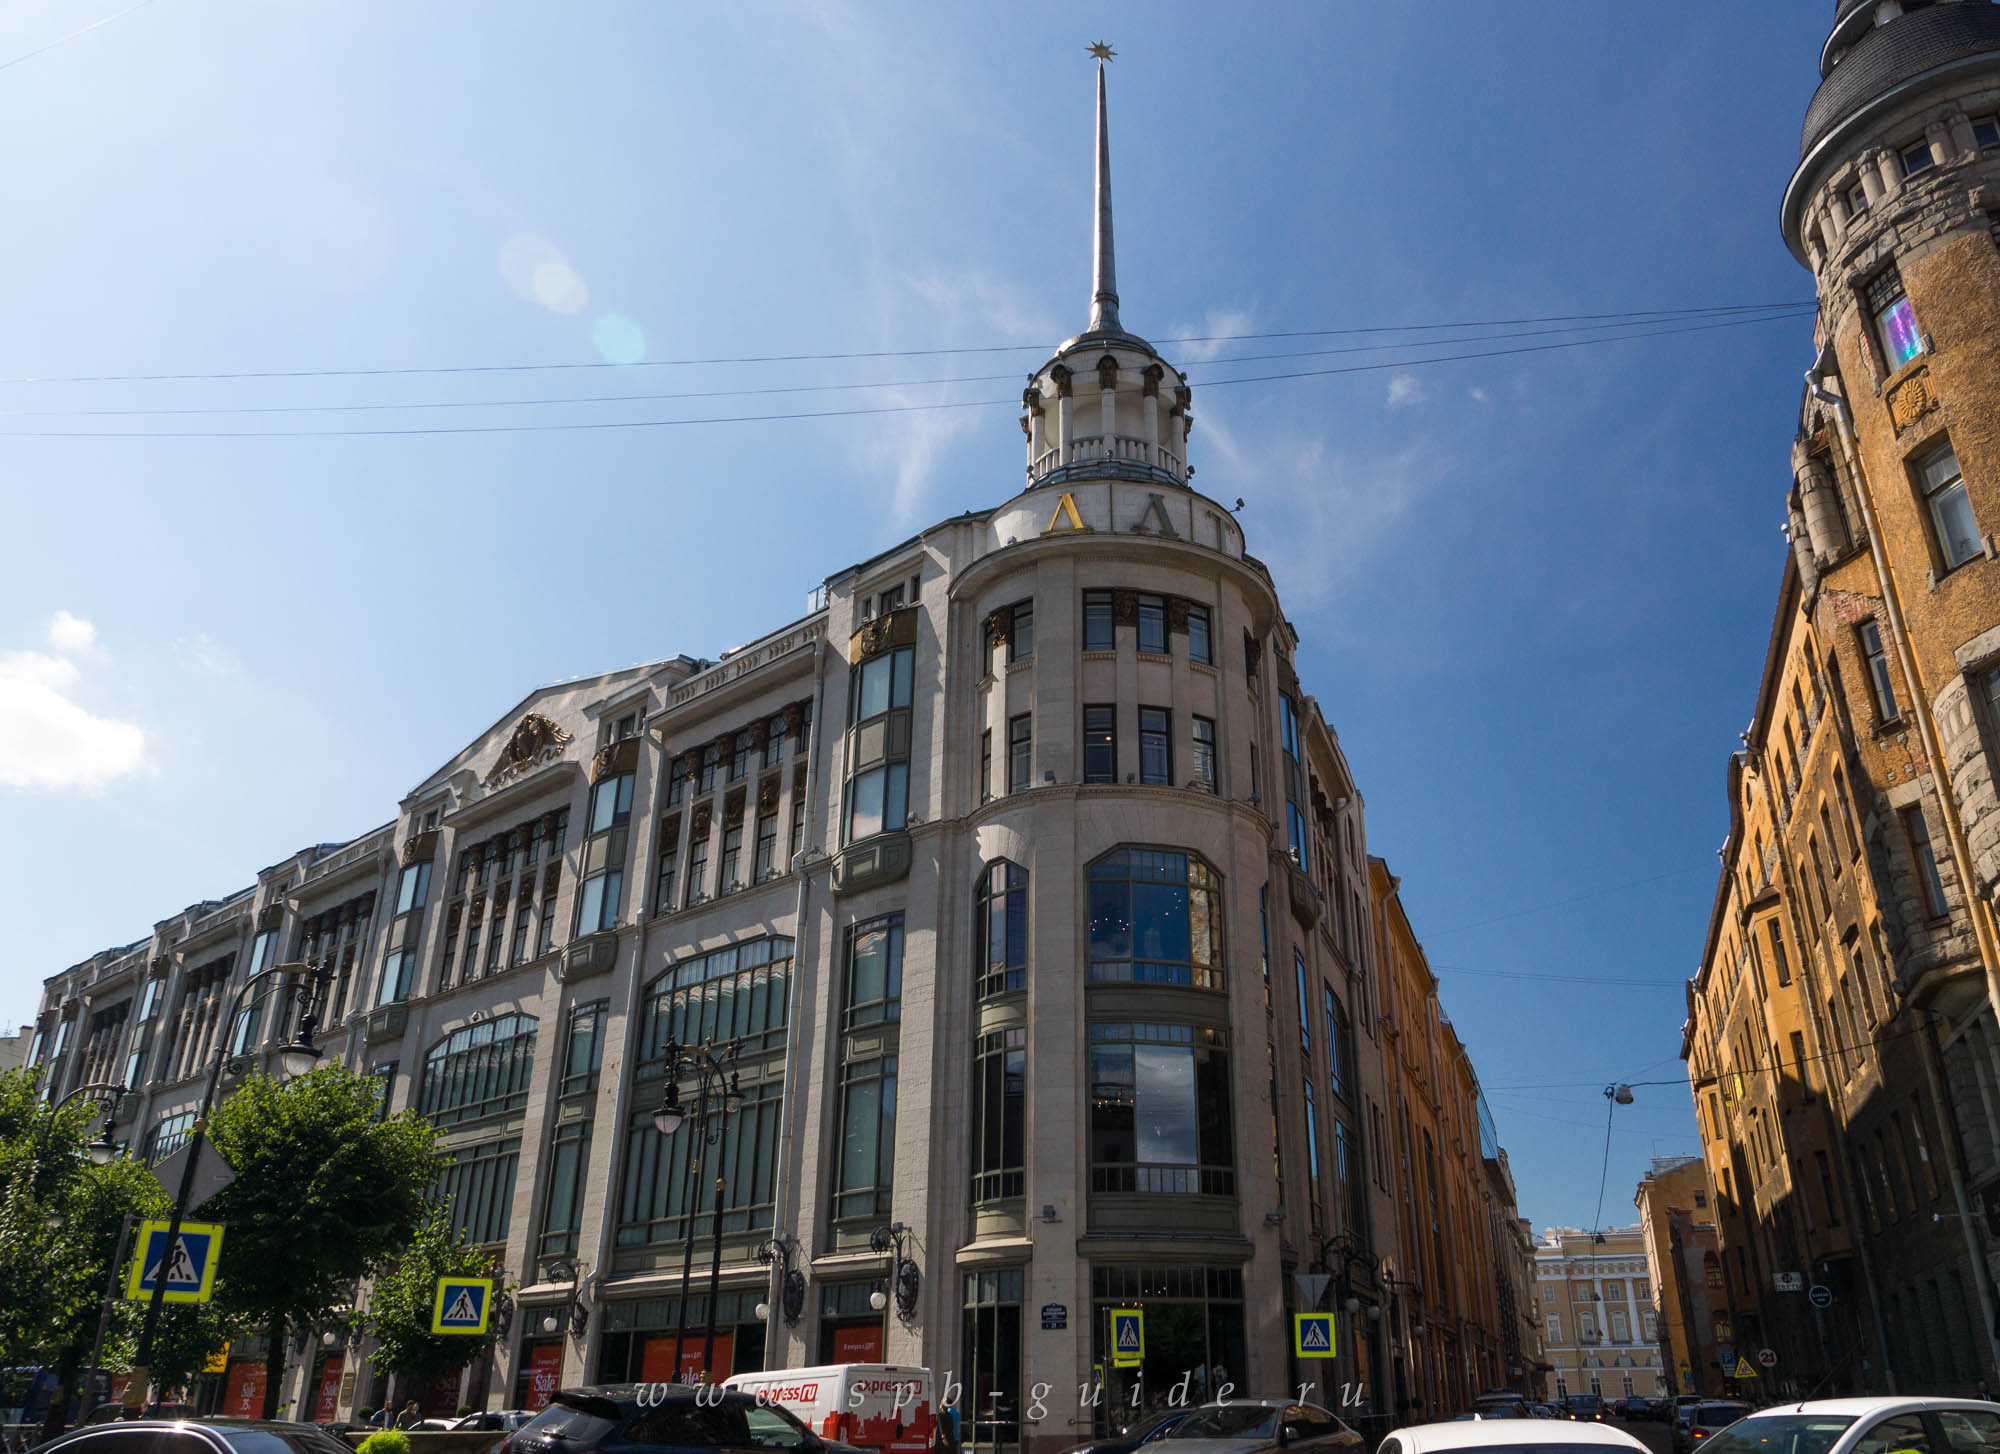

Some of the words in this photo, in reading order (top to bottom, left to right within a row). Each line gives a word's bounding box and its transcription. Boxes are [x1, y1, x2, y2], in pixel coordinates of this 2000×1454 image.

[1760, 1352, 1776, 1363] 21
[534, 1373, 556, 1392] Sale
[681, 1366, 699, 1384] ale
